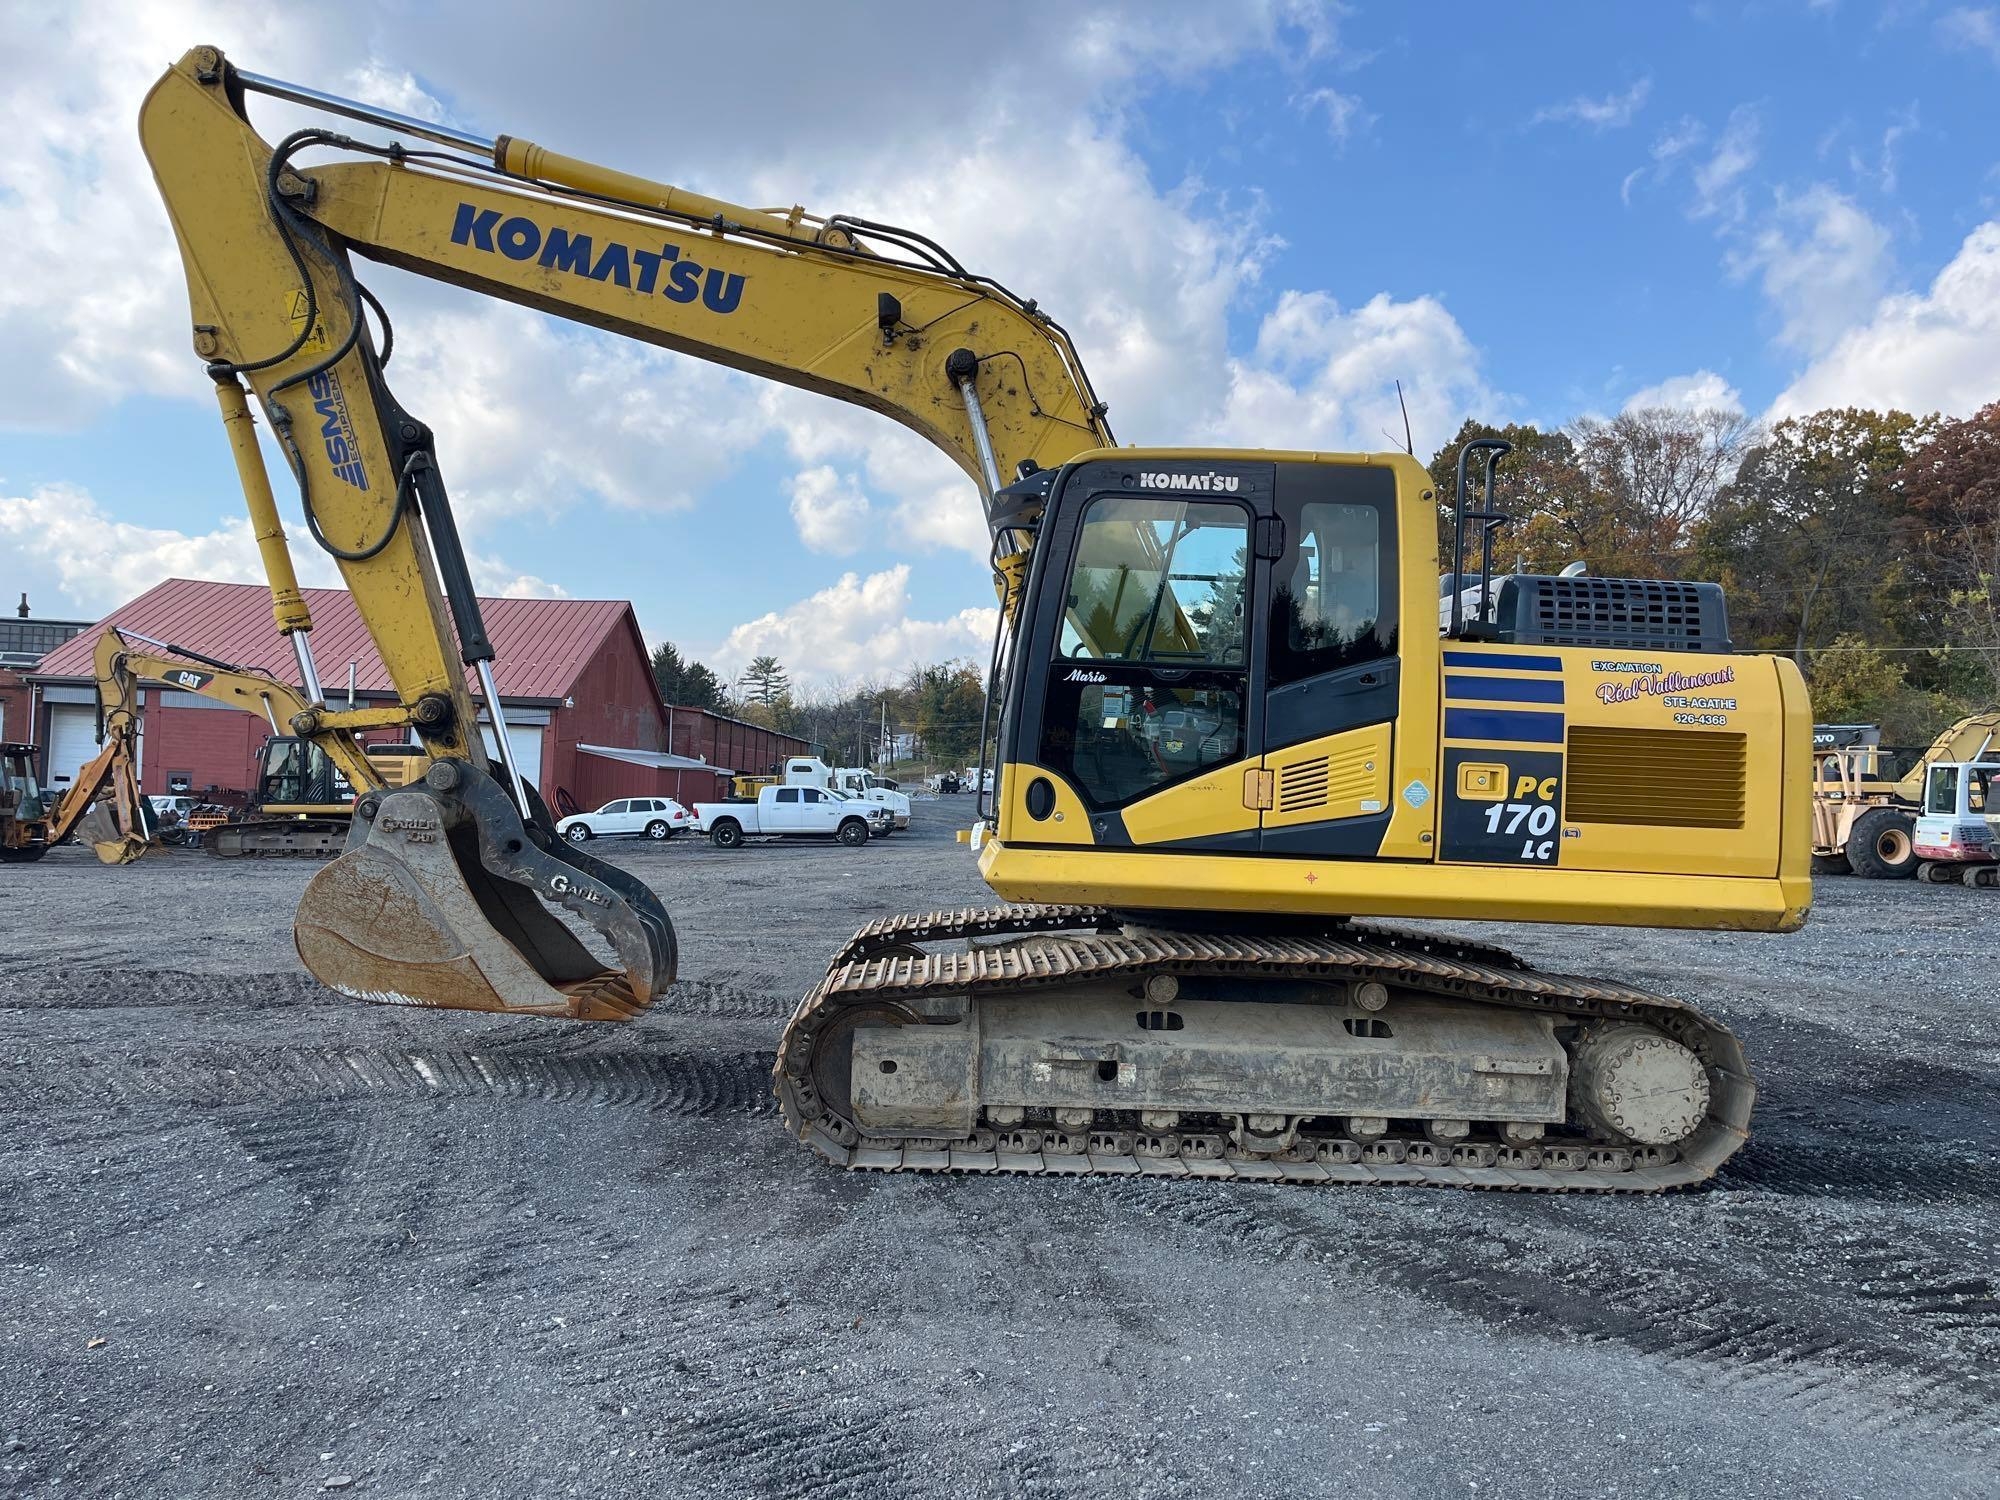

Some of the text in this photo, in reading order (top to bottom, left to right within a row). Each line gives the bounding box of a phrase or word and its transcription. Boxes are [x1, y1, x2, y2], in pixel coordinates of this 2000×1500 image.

[450, 202, 747, 314] KOMATSU
[307, 371, 350, 465] SMS
[326, 367, 359, 462] EQUIPMENT
[1140, 471, 1239, 492] KOMATSU
[1062, 668, 1108, 683] Mario
[1591, 660, 1663, 674] EXCAVATION
[178, 671, 202, 689] CAT
[1595, 666, 1736, 705] Réal Vaillancourt
[1663, 696, 1737, 710] STE-AGATHE
[1674, 712, 1728, 726] 326-4368
[1513, 775, 1558, 801] PC
[1484, 803, 1556, 836] 170
[1520, 840, 1554, 860] LC
